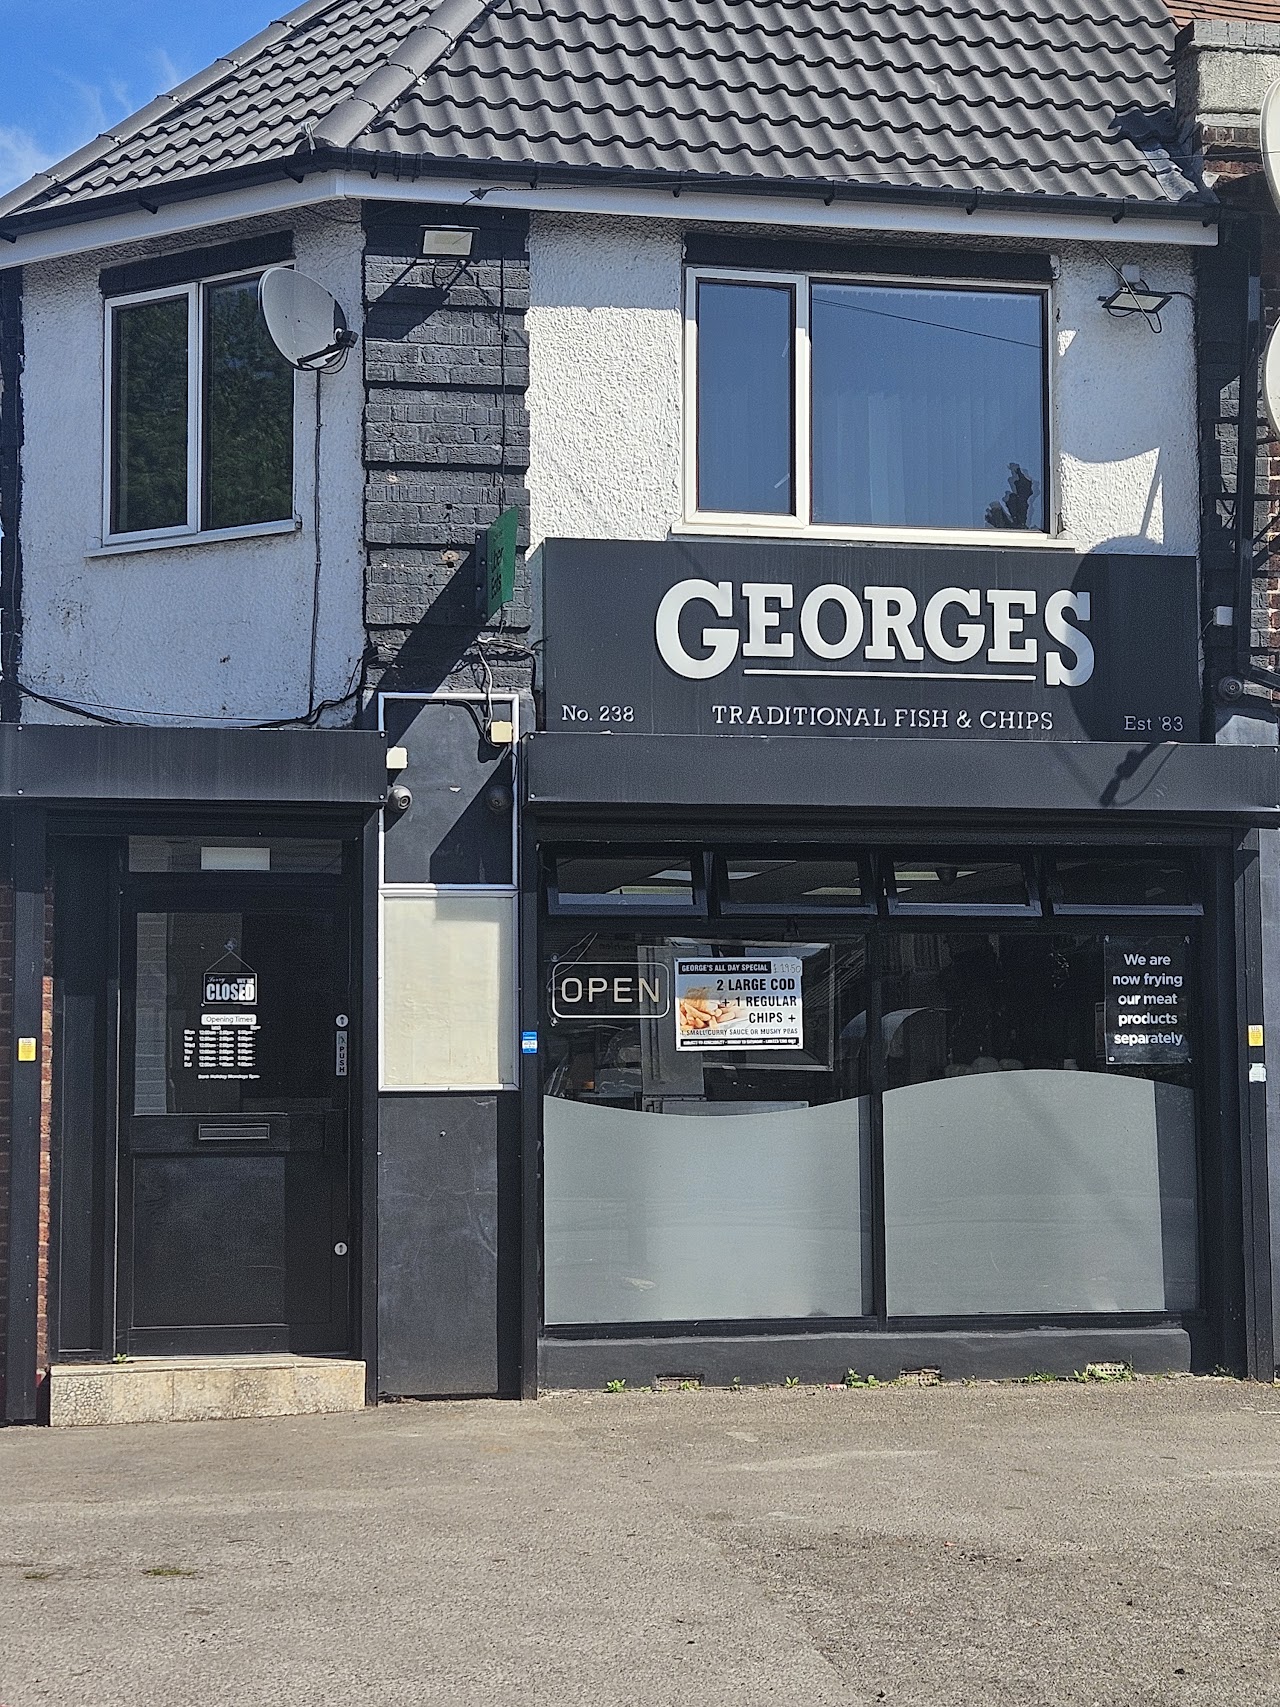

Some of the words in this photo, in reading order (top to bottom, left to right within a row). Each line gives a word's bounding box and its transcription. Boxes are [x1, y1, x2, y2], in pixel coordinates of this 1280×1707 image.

[655, 578, 1095, 688] GEORGES
[561, 704, 593, 722] No.
[599, 705, 634, 723] 238
[711, 705, 887, 728] TRADITIONAL
[894, 708, 949, 729] FISH
[956, 710, 973, 728] &
[980, 710, 1054, 731] CHIPS
[1124, 715, 1152, 731] Est
[1158, 716, 1184, 732] '83
[1123, 953, 1147, 966] We
[1149, 955, 1172, 966] are
[681, 964, 713, 972] GEORGE'S
[714, 964, 726, 972] ALL
[727, 964, 740, 972] DAY
[741, 963, 768, 972] SPECIAL
[716, 979, 724, 991] 2
[728, 978, 767, 991] LARGE
[770, 978, 796, 991] COD
[1112, 974, 1140, 986] now
[1143, 973, 1184, 987] frying
[206, 983, 255, 1001] CLOSED
[561, 977, 660, 1003] OPEN
[735, 996, 741, 1007] 1
[746, 996, 797, 1007] REGULAR
[1118, 994, 1142, 1006] our
[1143, 993, 1178, 1005] meat
[206, 1015, 234, 1023] Opening
[749, 1012, 783, 1024] CHIPS
[788, 1014, 796, 1023] +
[1118, 1012, 1178, 1027] products
[1114, 1032, 1183, 1047] separately
